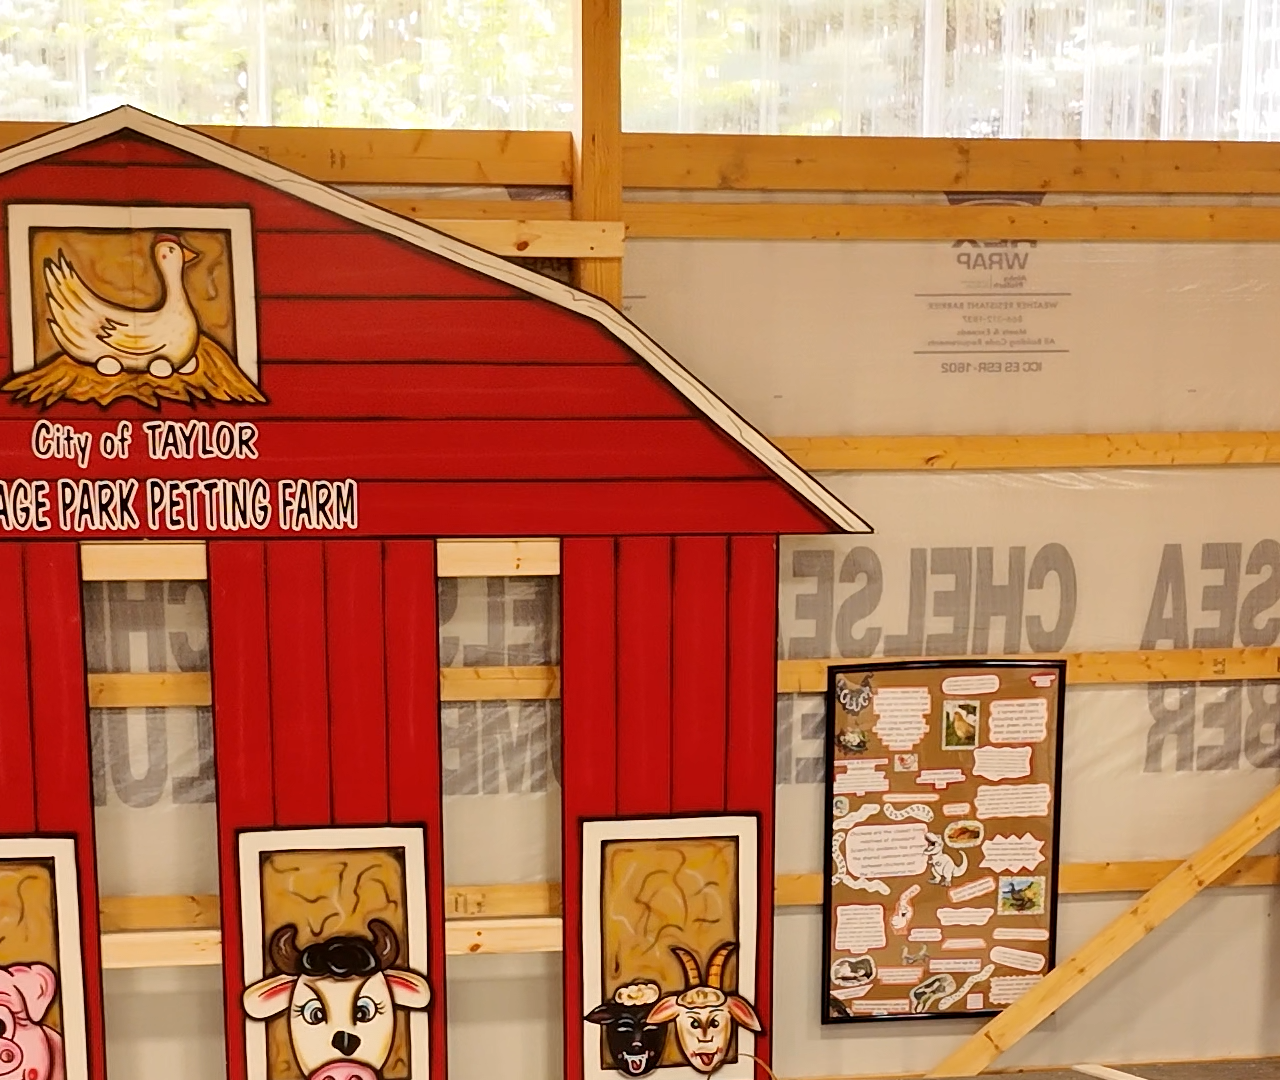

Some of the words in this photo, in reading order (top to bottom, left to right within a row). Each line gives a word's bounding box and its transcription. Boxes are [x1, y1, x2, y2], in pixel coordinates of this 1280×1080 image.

[31, 420, 92, 469] City
[99, 421, 131, 460] of
[142, 421, 259, 460] TAYLOR
[59, 478, 139, 532] PARK
[146, 478, 271, 530] PETTING
[278, 479, 358, 530] FARM
